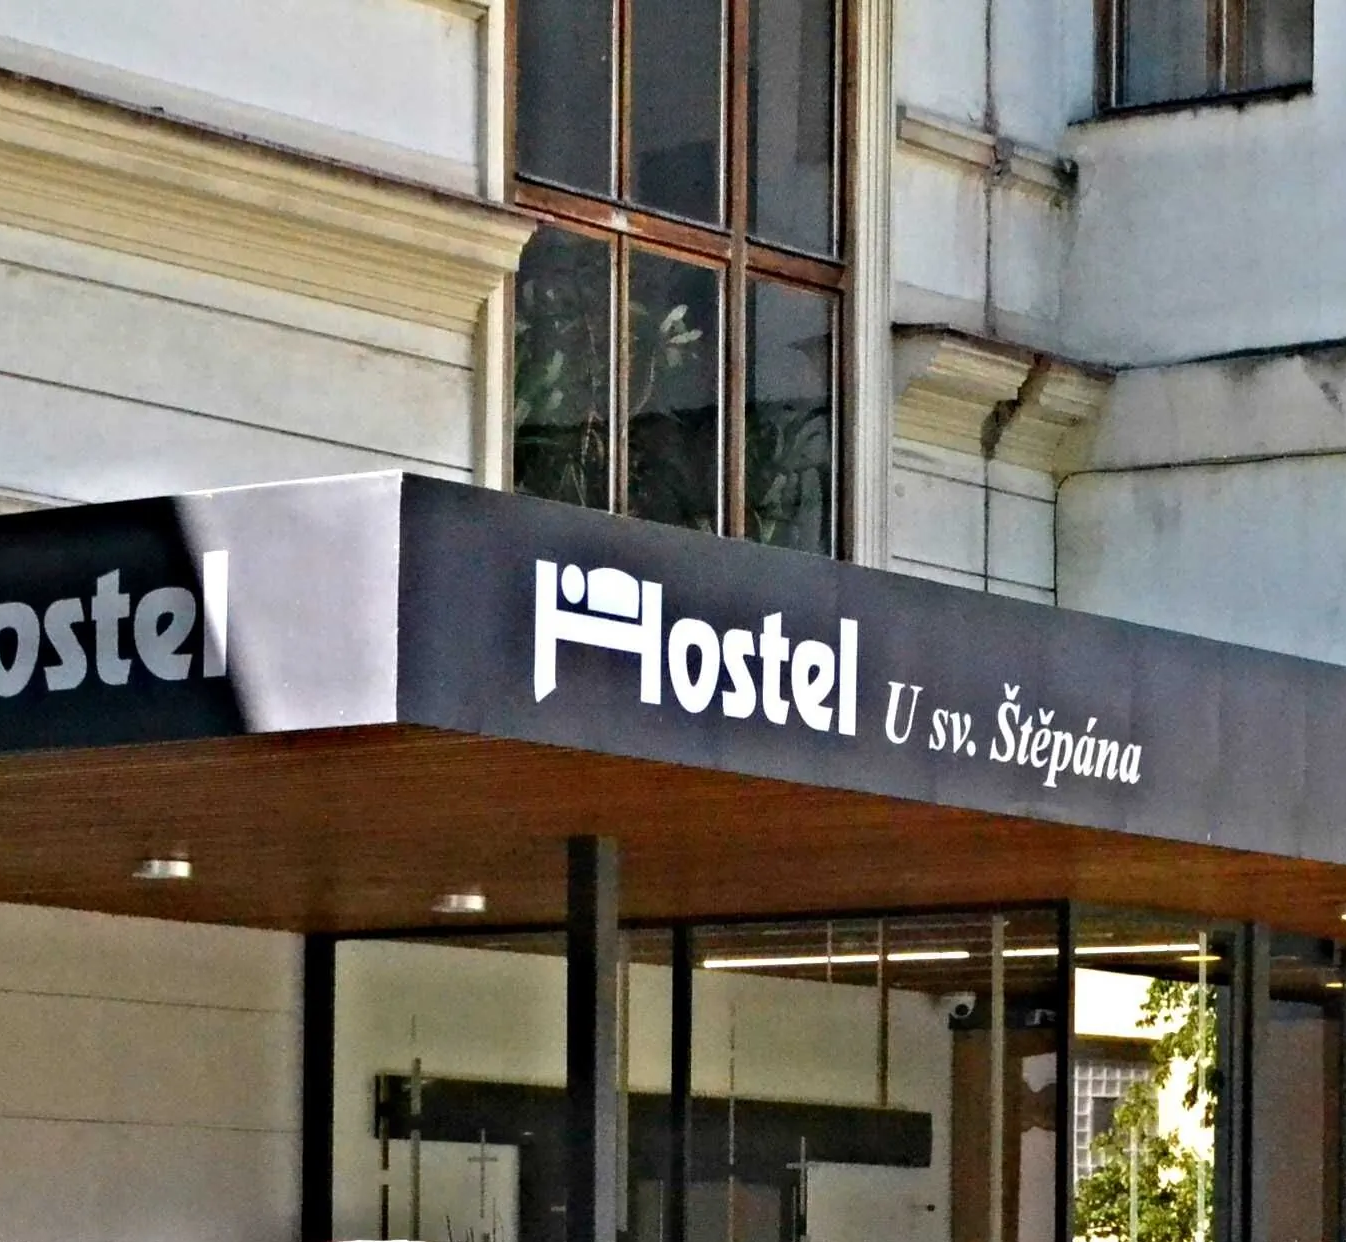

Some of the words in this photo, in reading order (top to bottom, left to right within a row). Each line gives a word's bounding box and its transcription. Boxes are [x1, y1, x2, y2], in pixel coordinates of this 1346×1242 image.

[533, 559, 859, 736] Hostel
[885, 681, 924, 745] U
[928, 708, 977, 757] sv.
[989, 682, 1143, 788] Štěpána
